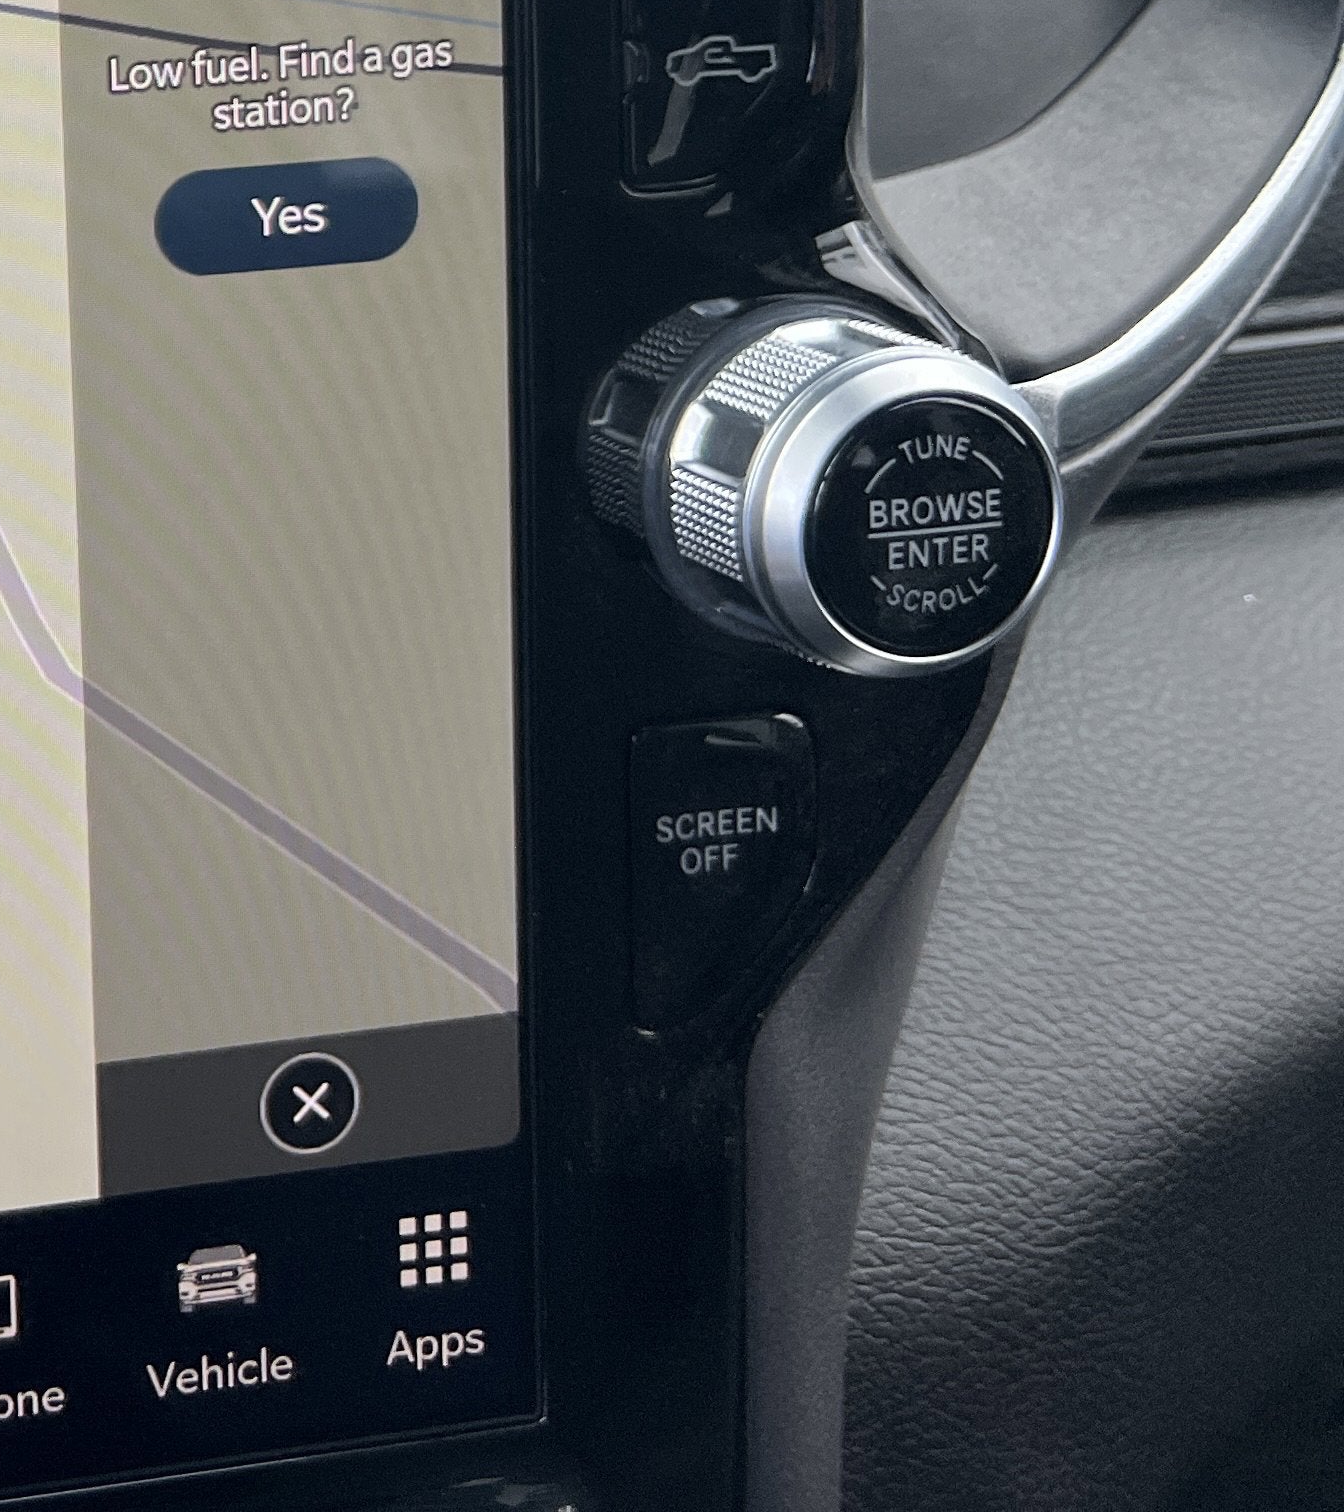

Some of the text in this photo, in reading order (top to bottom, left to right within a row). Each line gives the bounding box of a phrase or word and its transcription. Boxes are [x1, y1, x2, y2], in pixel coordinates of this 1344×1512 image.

[109, 38, 454, 92] Low fuel. Find a gas
[212, 88, 354, 132] station?
[251, 194, 327, 237] Yes
[898, 433, 973, 465] TUNE
[868, 488, 1003, 530] BROWSE
[887, 533, 989, 572] ENTER
[886, 581, 988, 614] SCROLL
[656, 807, 779, 844] SCREEN
[680, 844, 739, 876] OFF
[387, 1324, 487, 1370] Apps
[146, 1345, 294, 1399] Vehicle
